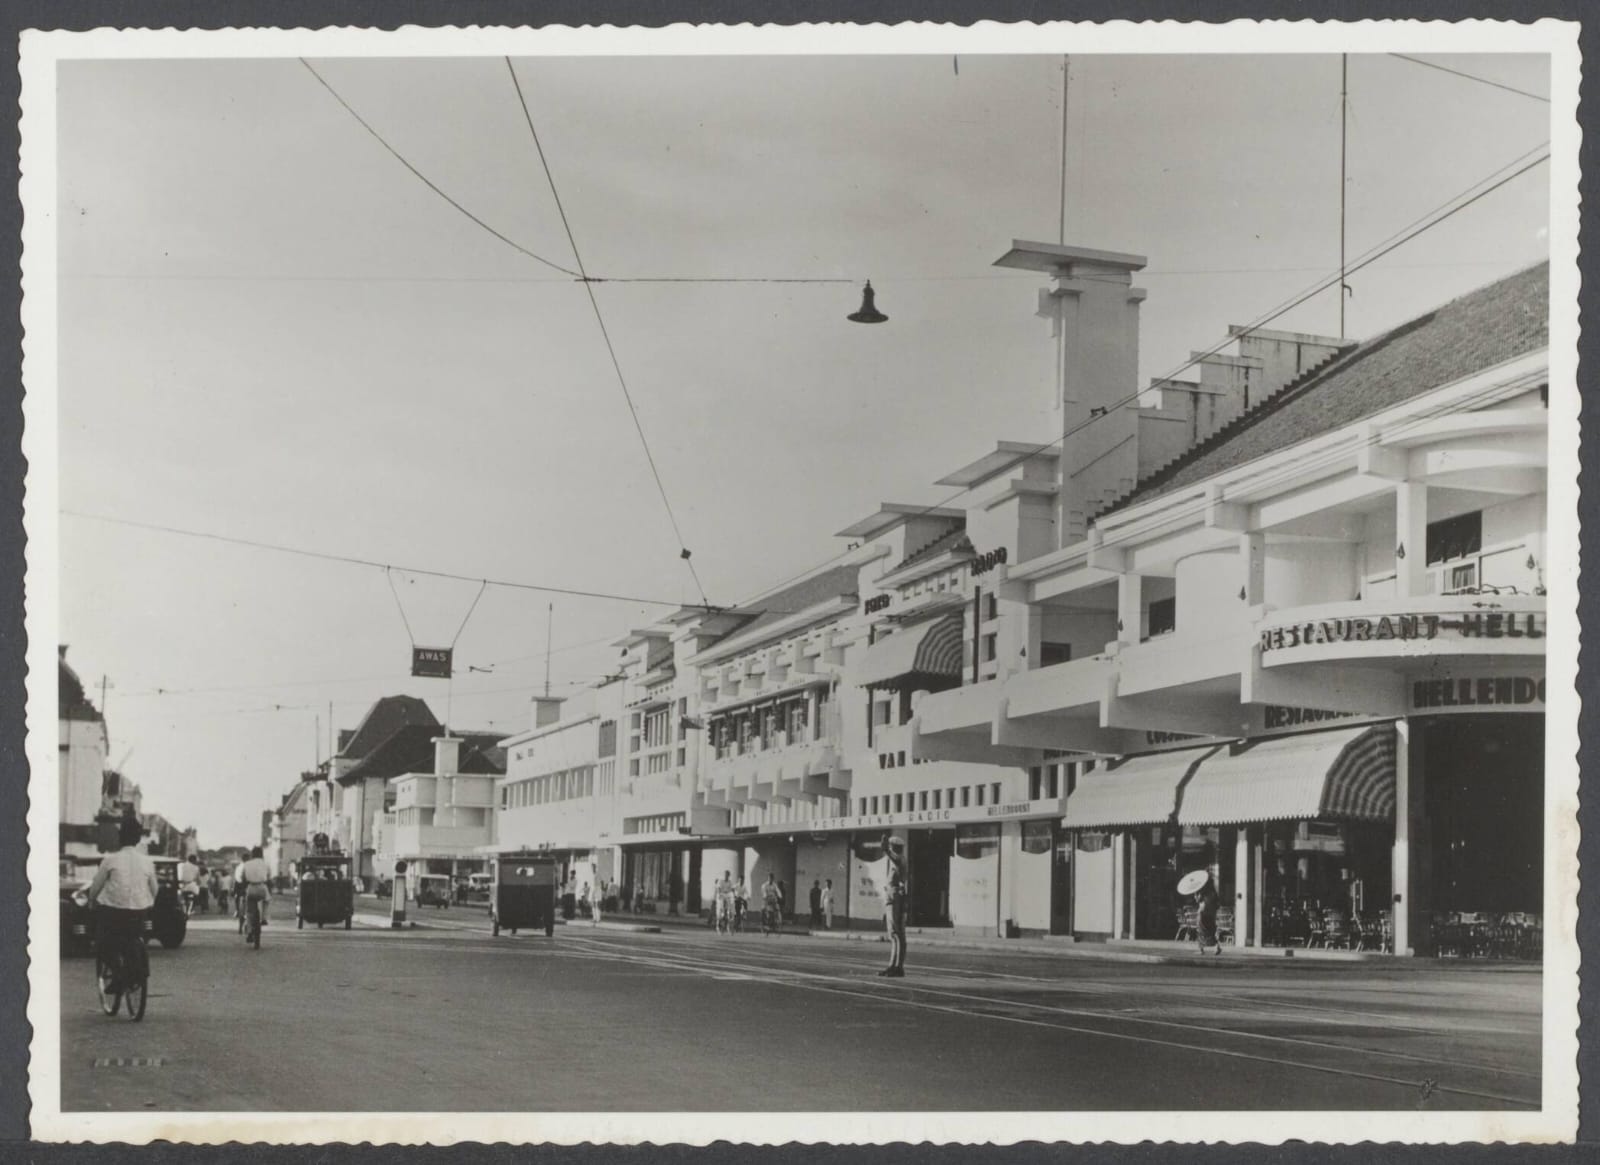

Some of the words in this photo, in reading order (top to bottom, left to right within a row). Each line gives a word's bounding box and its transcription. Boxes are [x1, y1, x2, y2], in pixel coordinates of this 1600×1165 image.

[1260, 616, 1439, 651] RESTAURANT
[1463, 613, 1546, 638] HELL
[418, 650, 447, 662] AWAS
